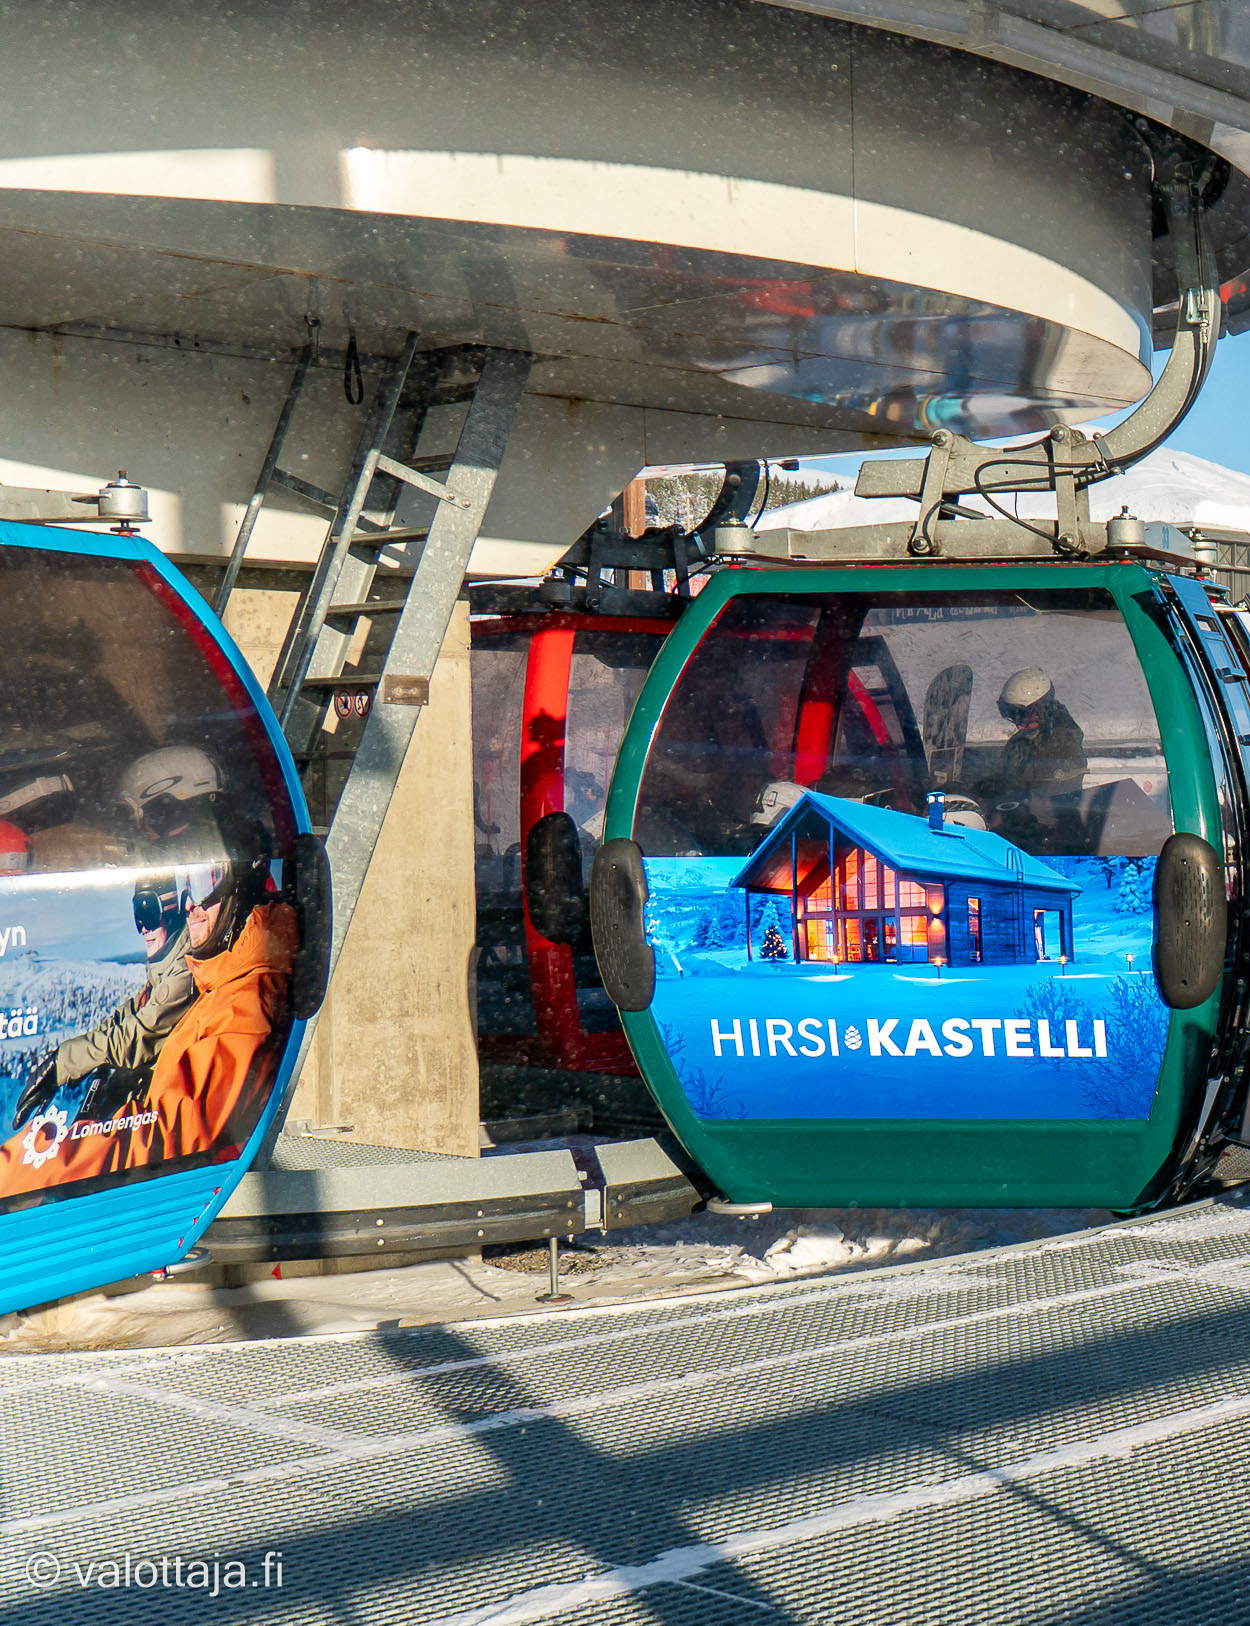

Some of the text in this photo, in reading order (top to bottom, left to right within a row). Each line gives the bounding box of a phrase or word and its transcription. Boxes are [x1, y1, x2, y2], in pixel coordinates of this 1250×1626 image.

[710, 1018, 1108, 1057] HIRSI KASTELLI
[70, 1109, 159, 1140] Lomarengas
